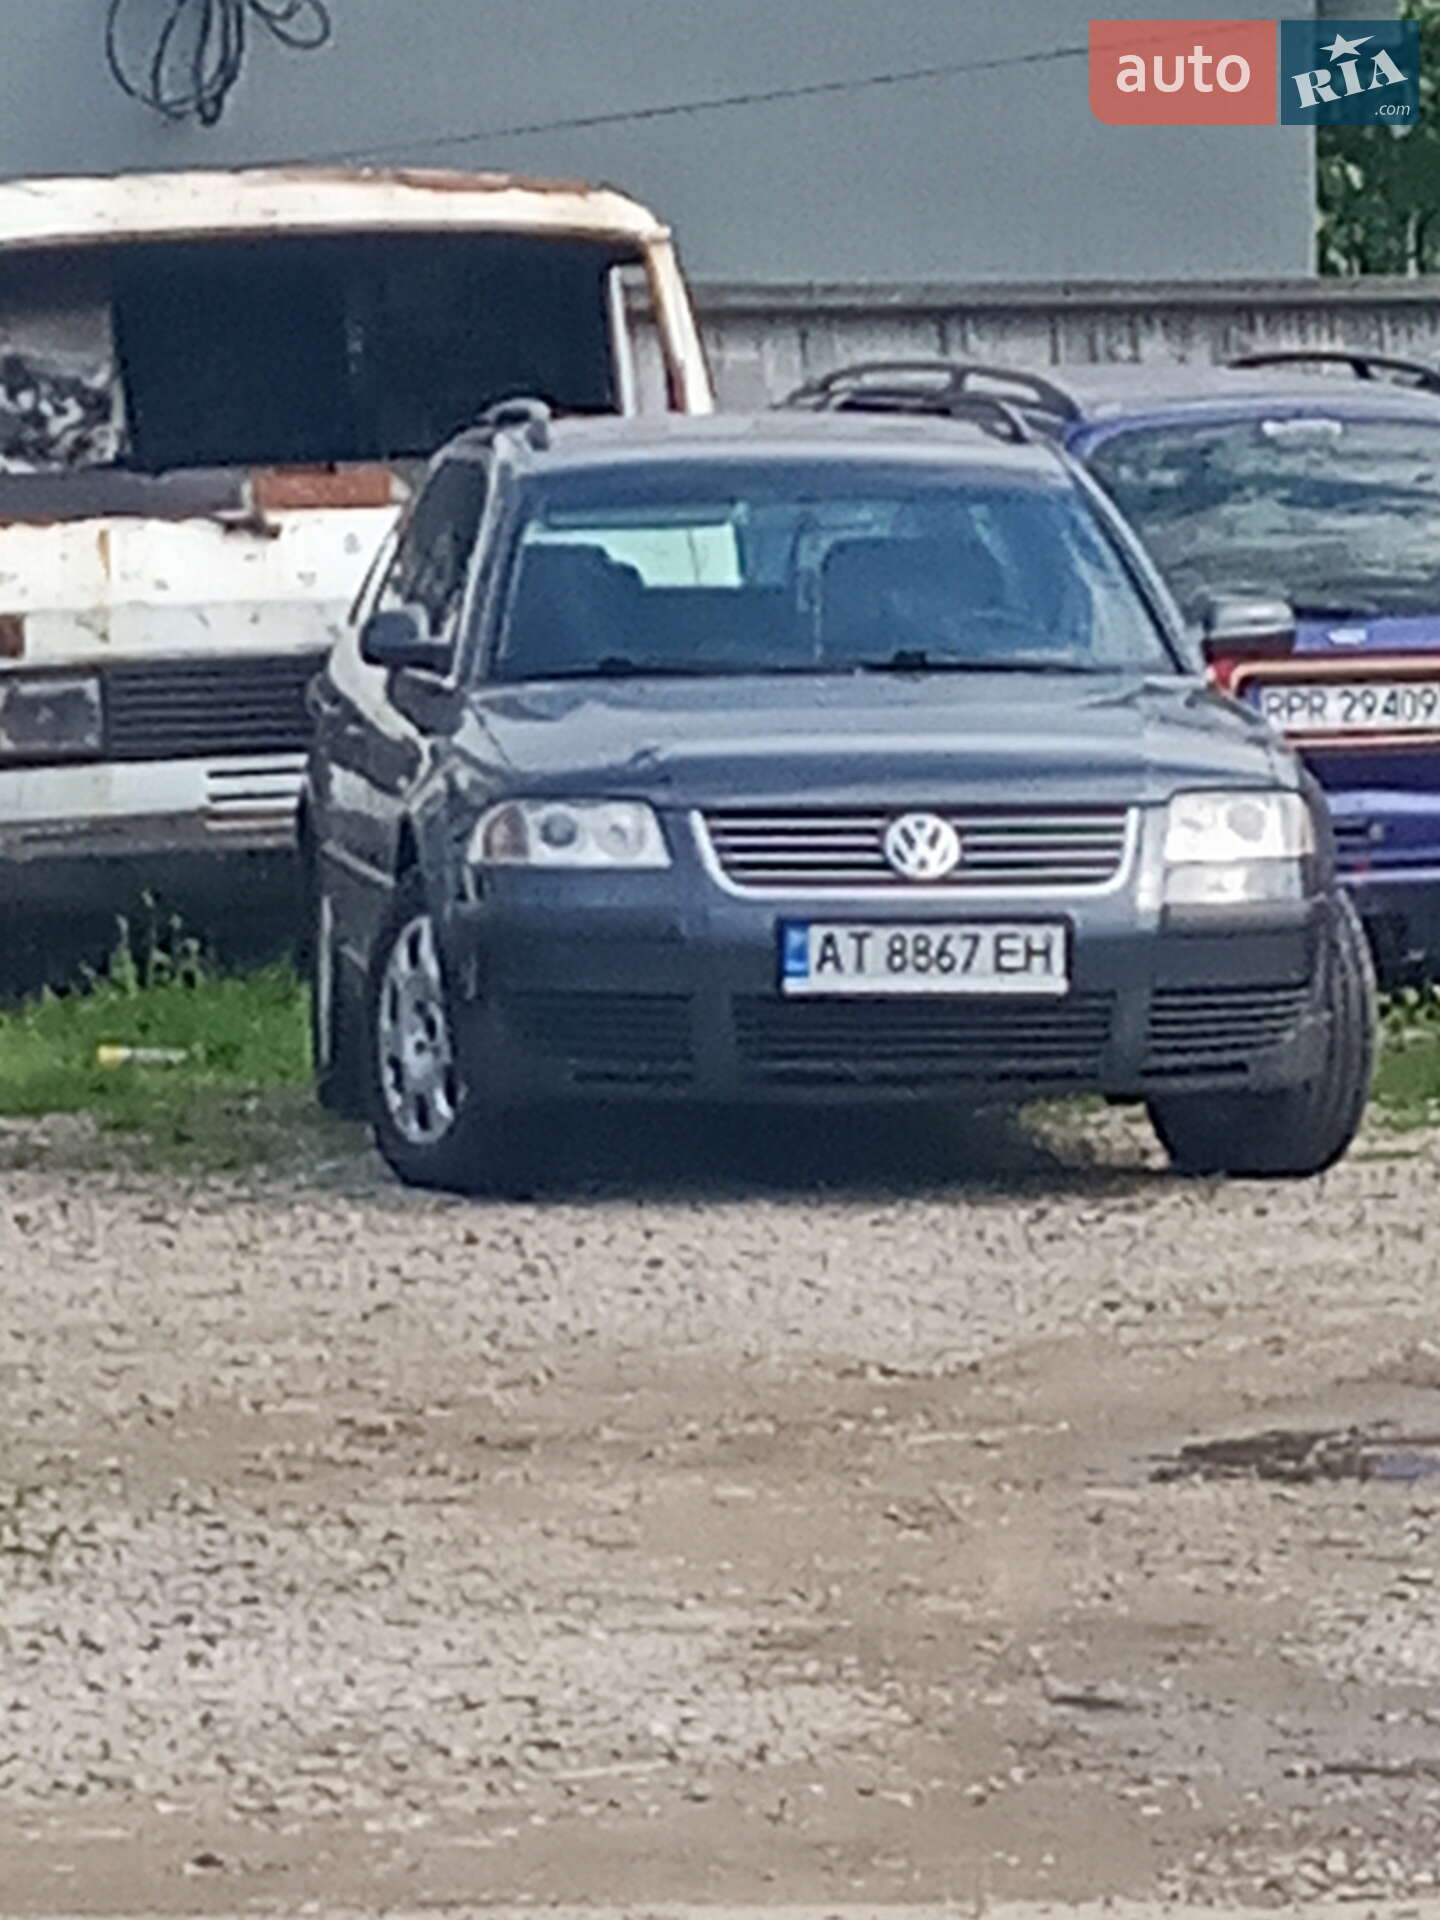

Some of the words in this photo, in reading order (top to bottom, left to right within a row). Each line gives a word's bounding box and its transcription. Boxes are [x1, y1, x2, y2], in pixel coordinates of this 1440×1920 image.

[815, 931, 872, 974] AT
[886, 932, 981, 974] 8867
[994, 932, 1051, 974] EH
